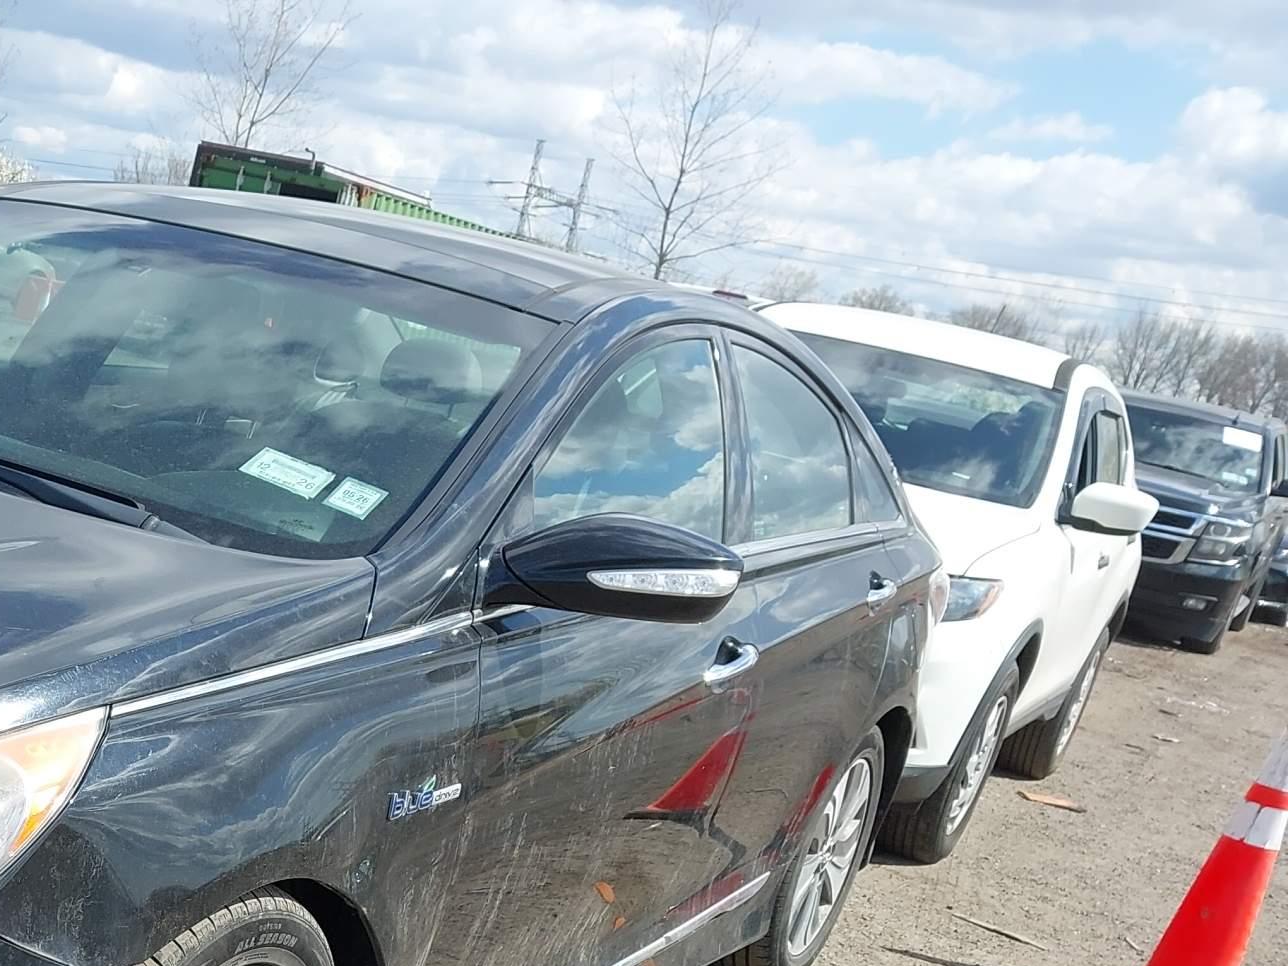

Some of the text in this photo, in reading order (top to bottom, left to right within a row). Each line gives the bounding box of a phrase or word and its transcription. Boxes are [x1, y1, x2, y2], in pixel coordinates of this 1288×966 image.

[296, 478, 315, 490] 26
[234, 932, 298, 954] ALL SEASON
